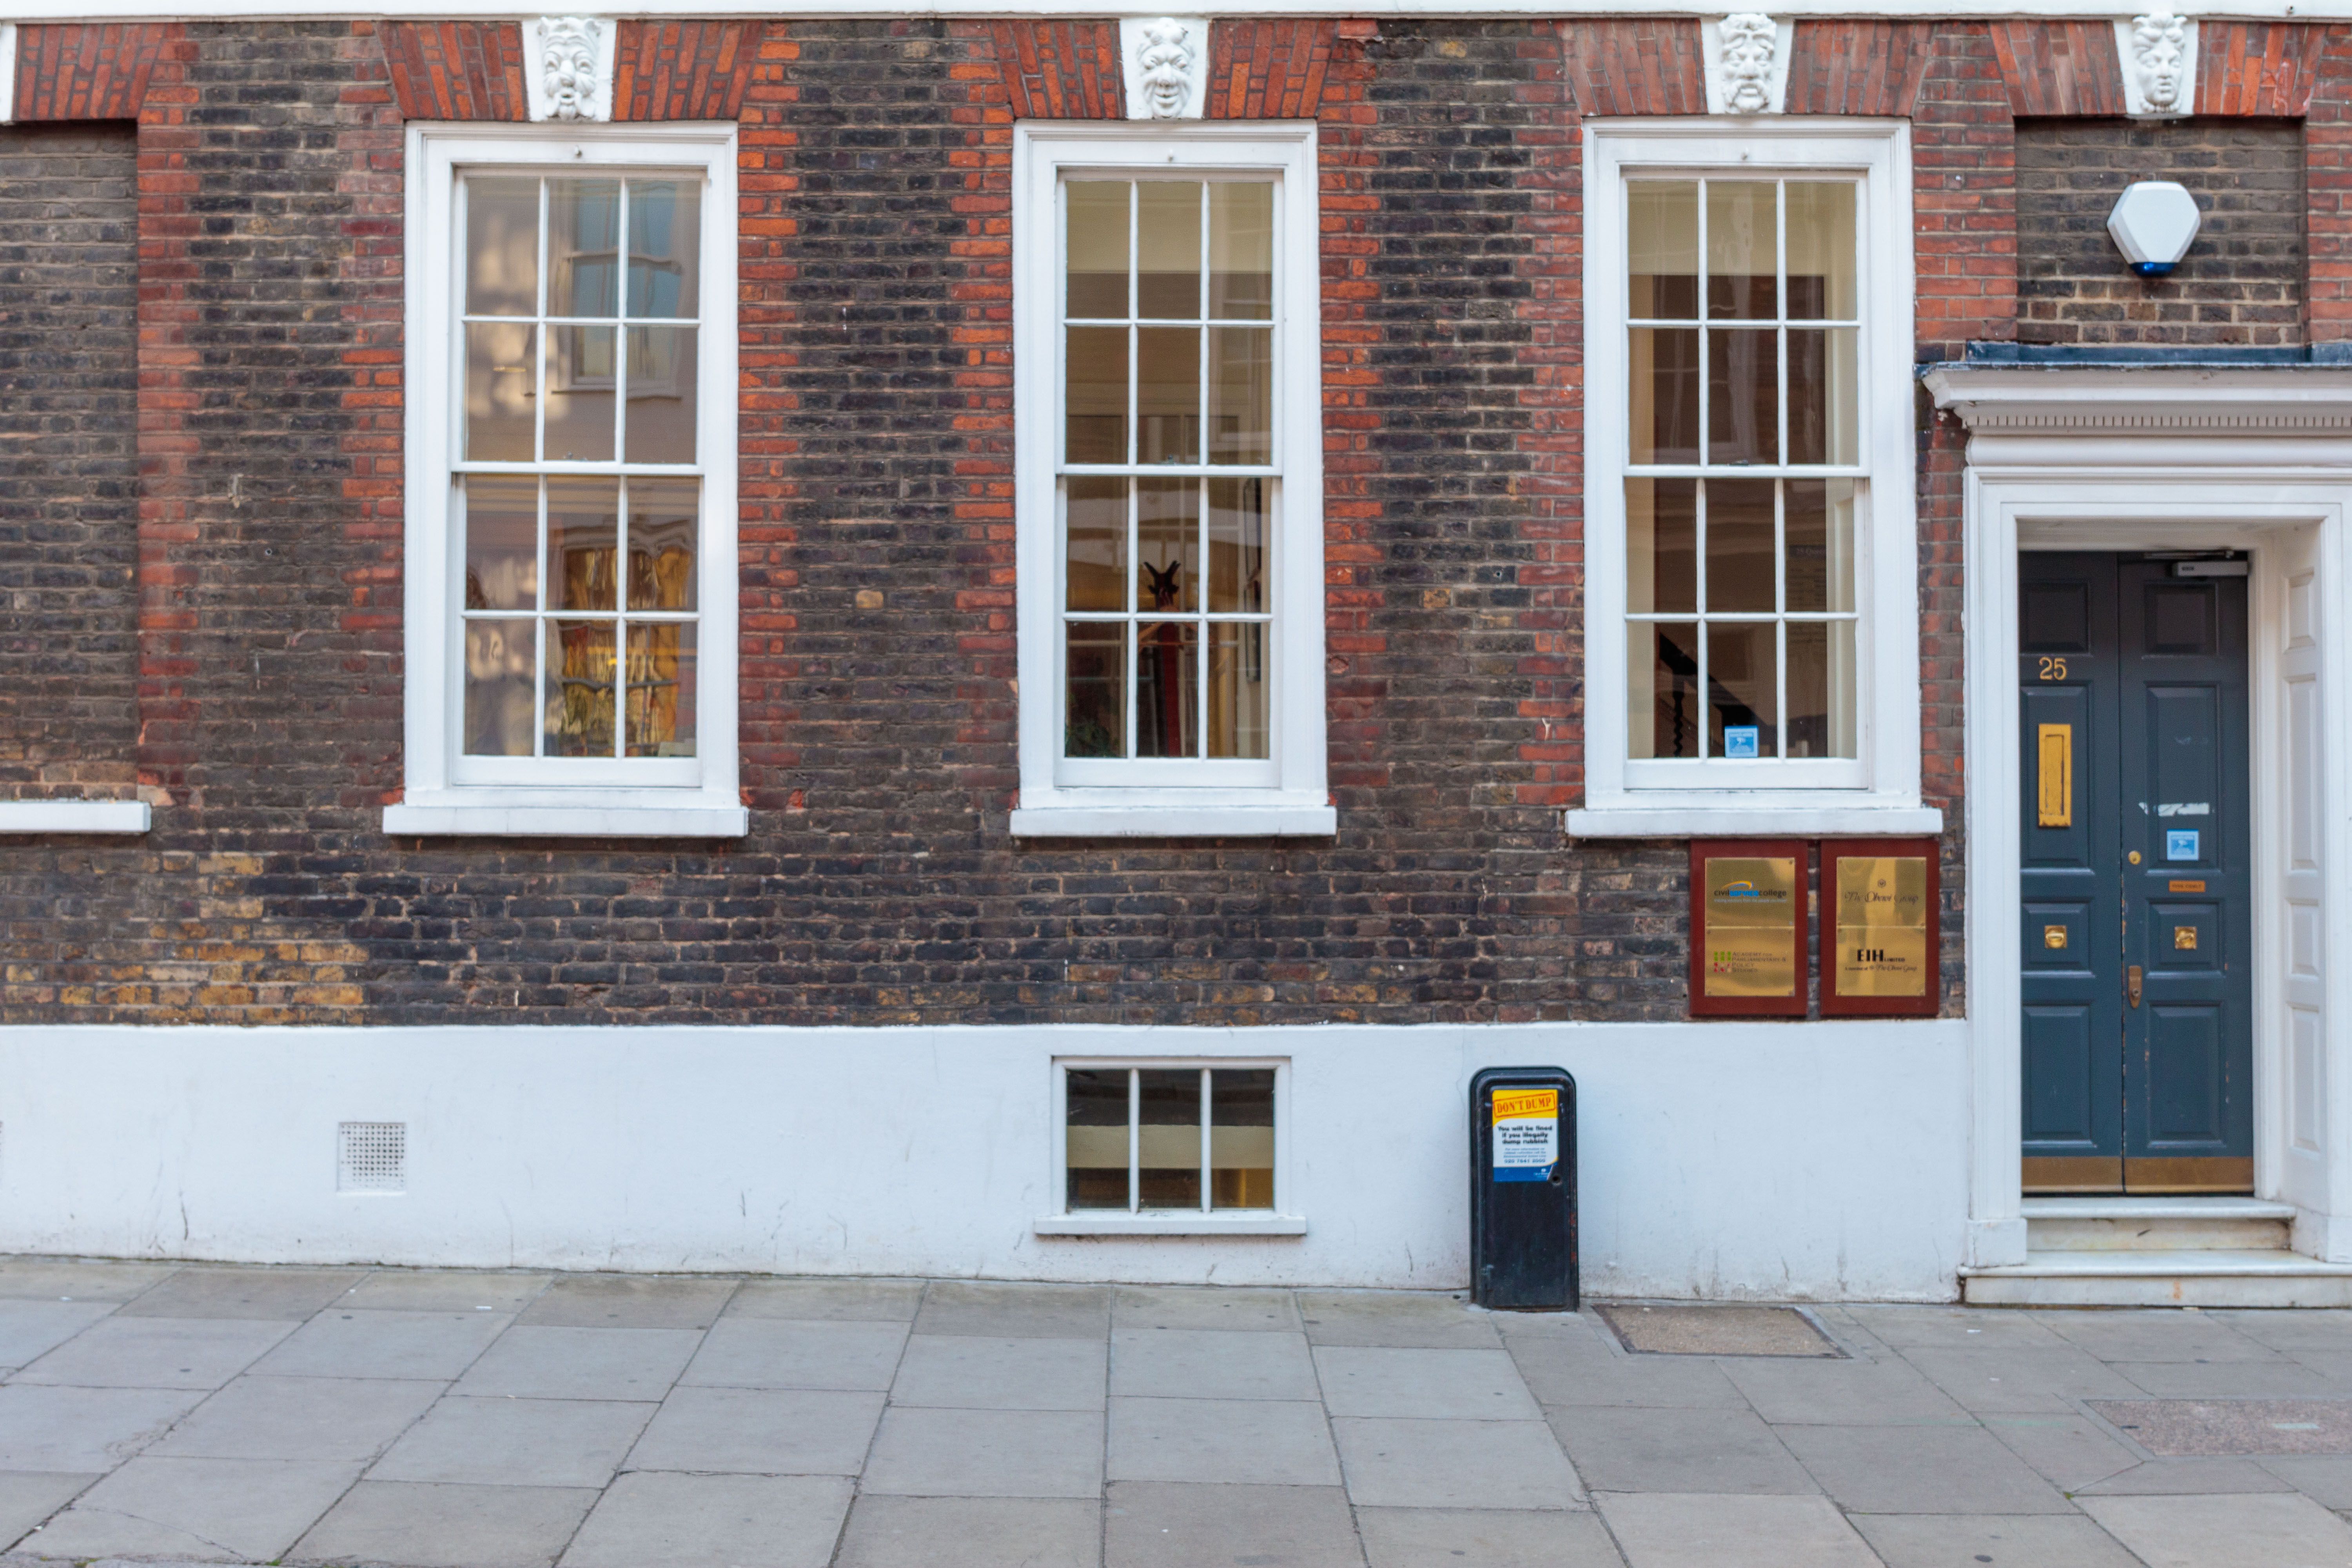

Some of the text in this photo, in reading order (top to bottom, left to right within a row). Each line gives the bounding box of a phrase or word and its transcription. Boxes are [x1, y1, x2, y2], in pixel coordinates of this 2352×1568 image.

[2039, 656, 2067, 681] 25
[1844, 891, 1861, 902] The
[1857, 949, 1883, 961] EIH
[1497, 1097, 1551, 1113] DON'T DUMP
